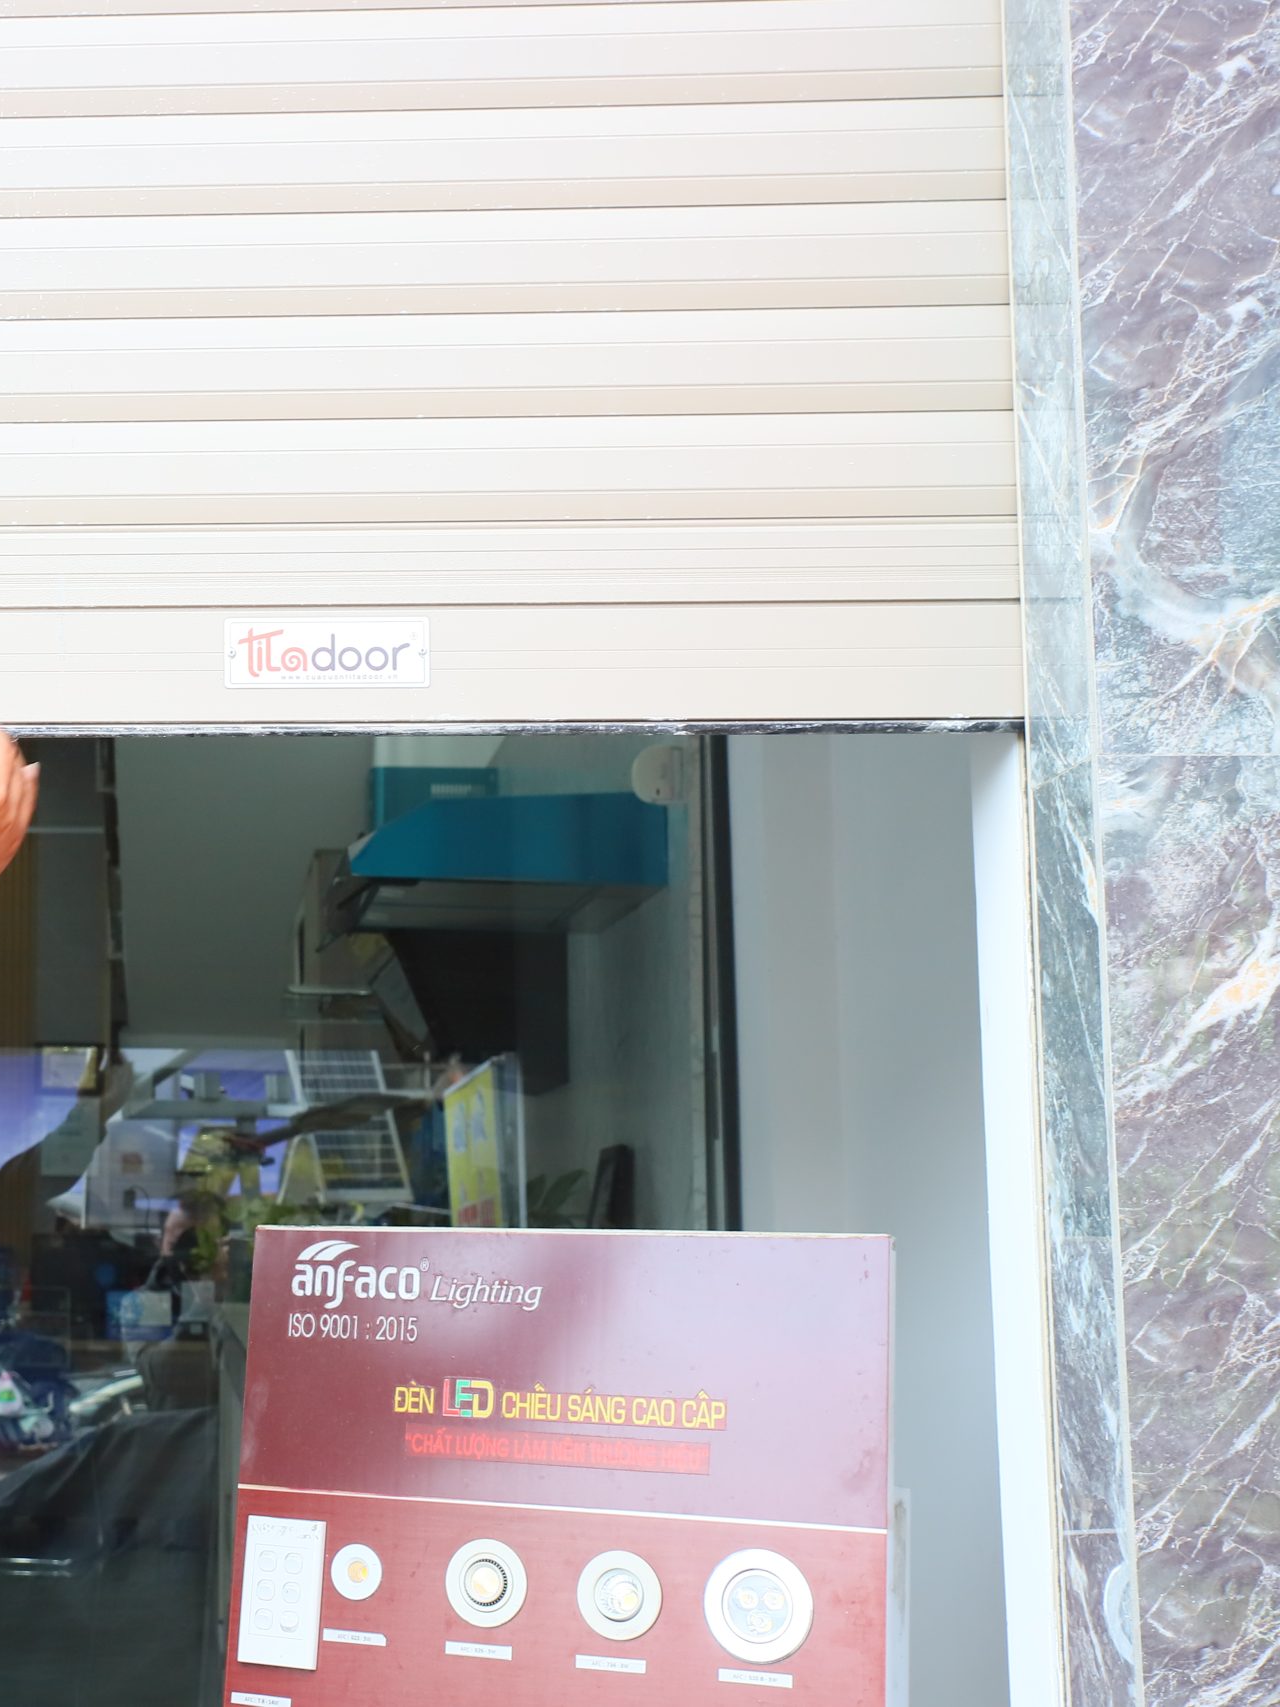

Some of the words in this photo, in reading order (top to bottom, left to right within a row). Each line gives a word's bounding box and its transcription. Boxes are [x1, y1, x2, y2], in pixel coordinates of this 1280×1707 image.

[430, 1275, 543, 1312] Lighting
[288, 1313, 315, 1338] ISO
[320, 1314, 359, 1340] 9001
[375, 1316, 418, 1342] 2015
[442, 1378, 494, 1419] LED
[568, 1387, 625, 1424] SÁNG
[631, 1398, 675, 1427] CAO
